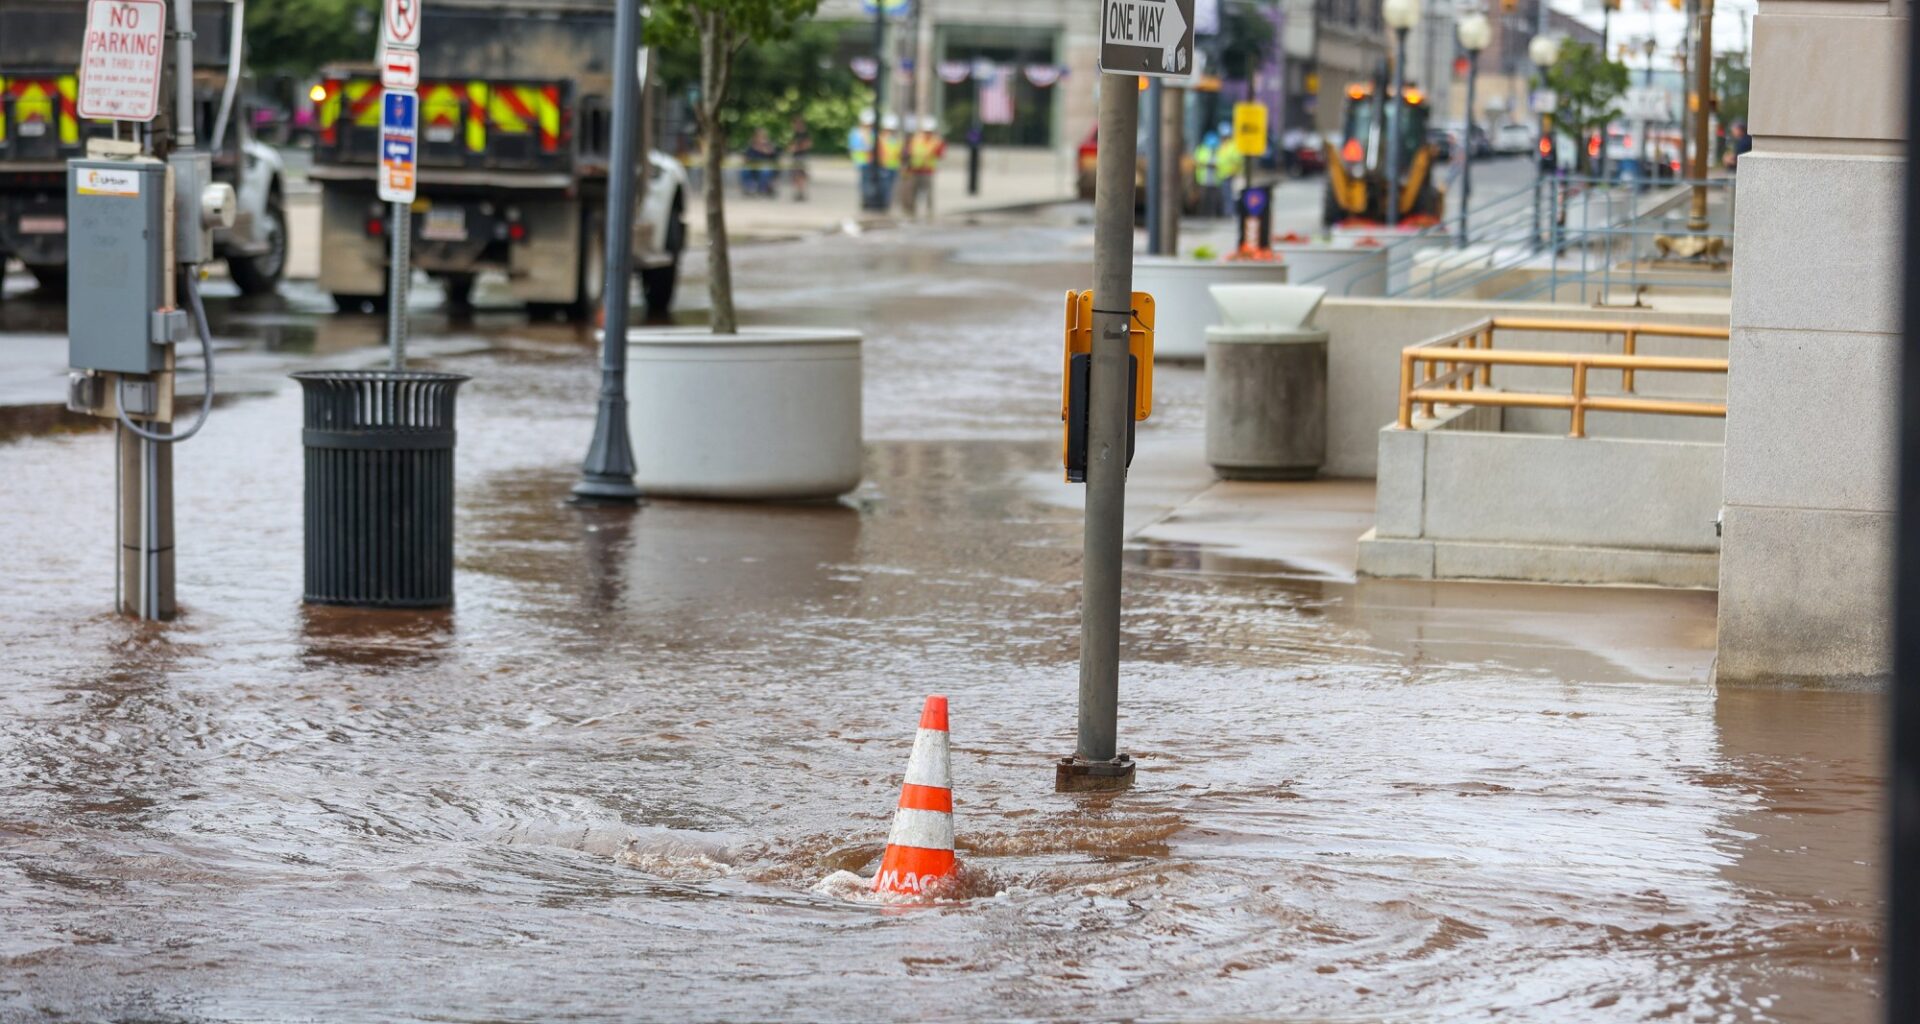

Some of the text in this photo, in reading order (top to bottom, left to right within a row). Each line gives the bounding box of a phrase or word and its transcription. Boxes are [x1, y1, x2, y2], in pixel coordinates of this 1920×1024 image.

[110, 6, 139, 29] NO
[1110, 1, 1165, 43] ONE WAY
[89, 31, 157, 56] PARKING
